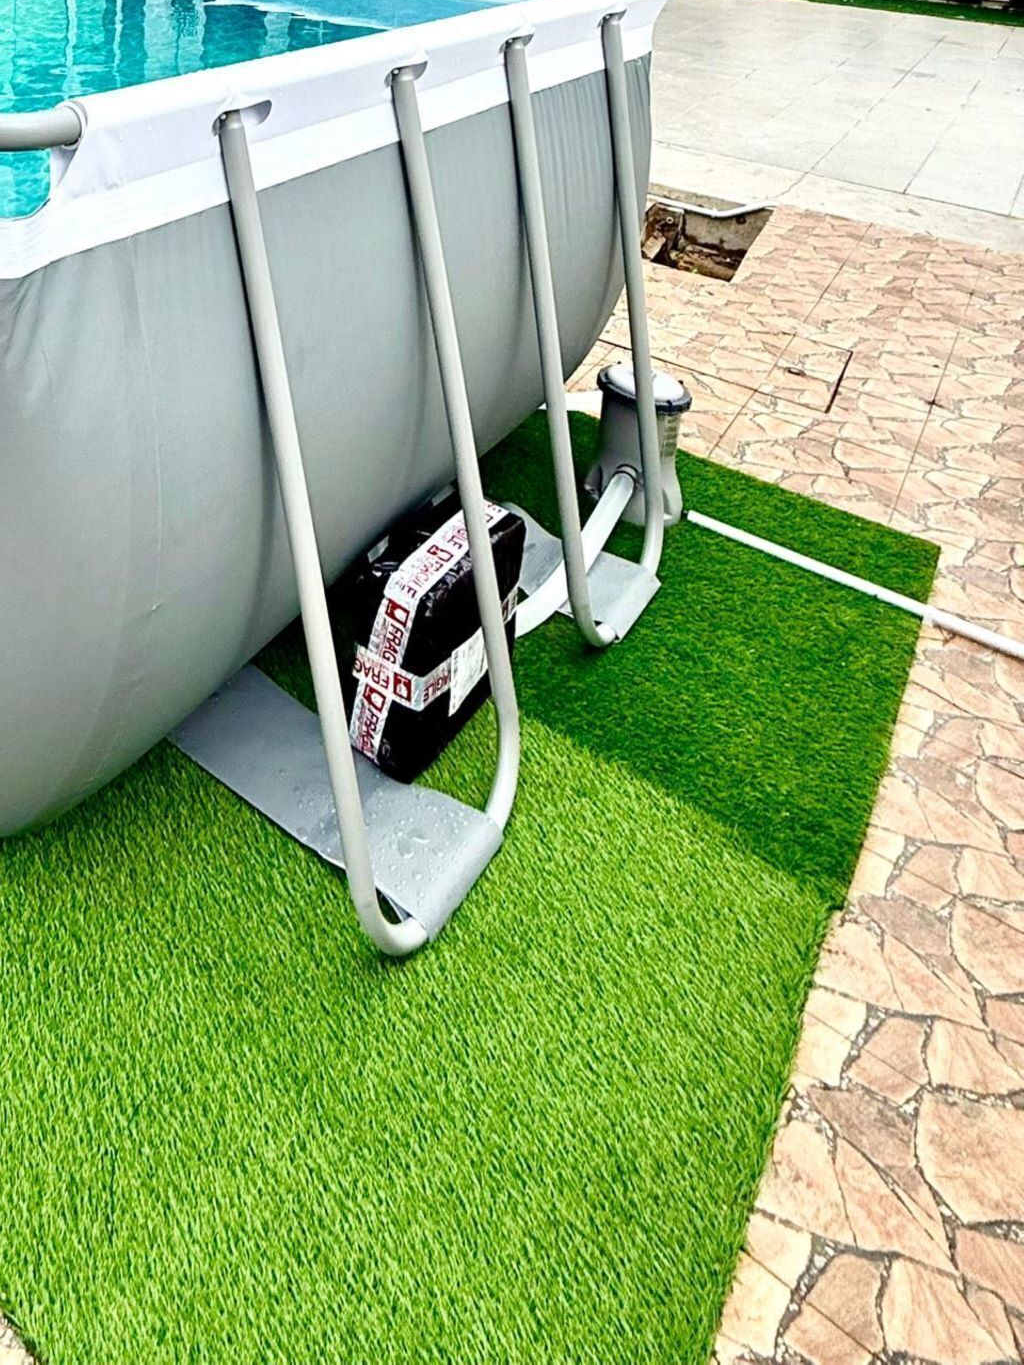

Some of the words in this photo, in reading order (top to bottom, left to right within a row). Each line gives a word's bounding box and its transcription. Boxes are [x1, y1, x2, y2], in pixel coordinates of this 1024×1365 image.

[382, 623, 404, 664] FRAG
[354, 657, 389, 690] FRAG
[423, 671, 450, 703] AGILE
